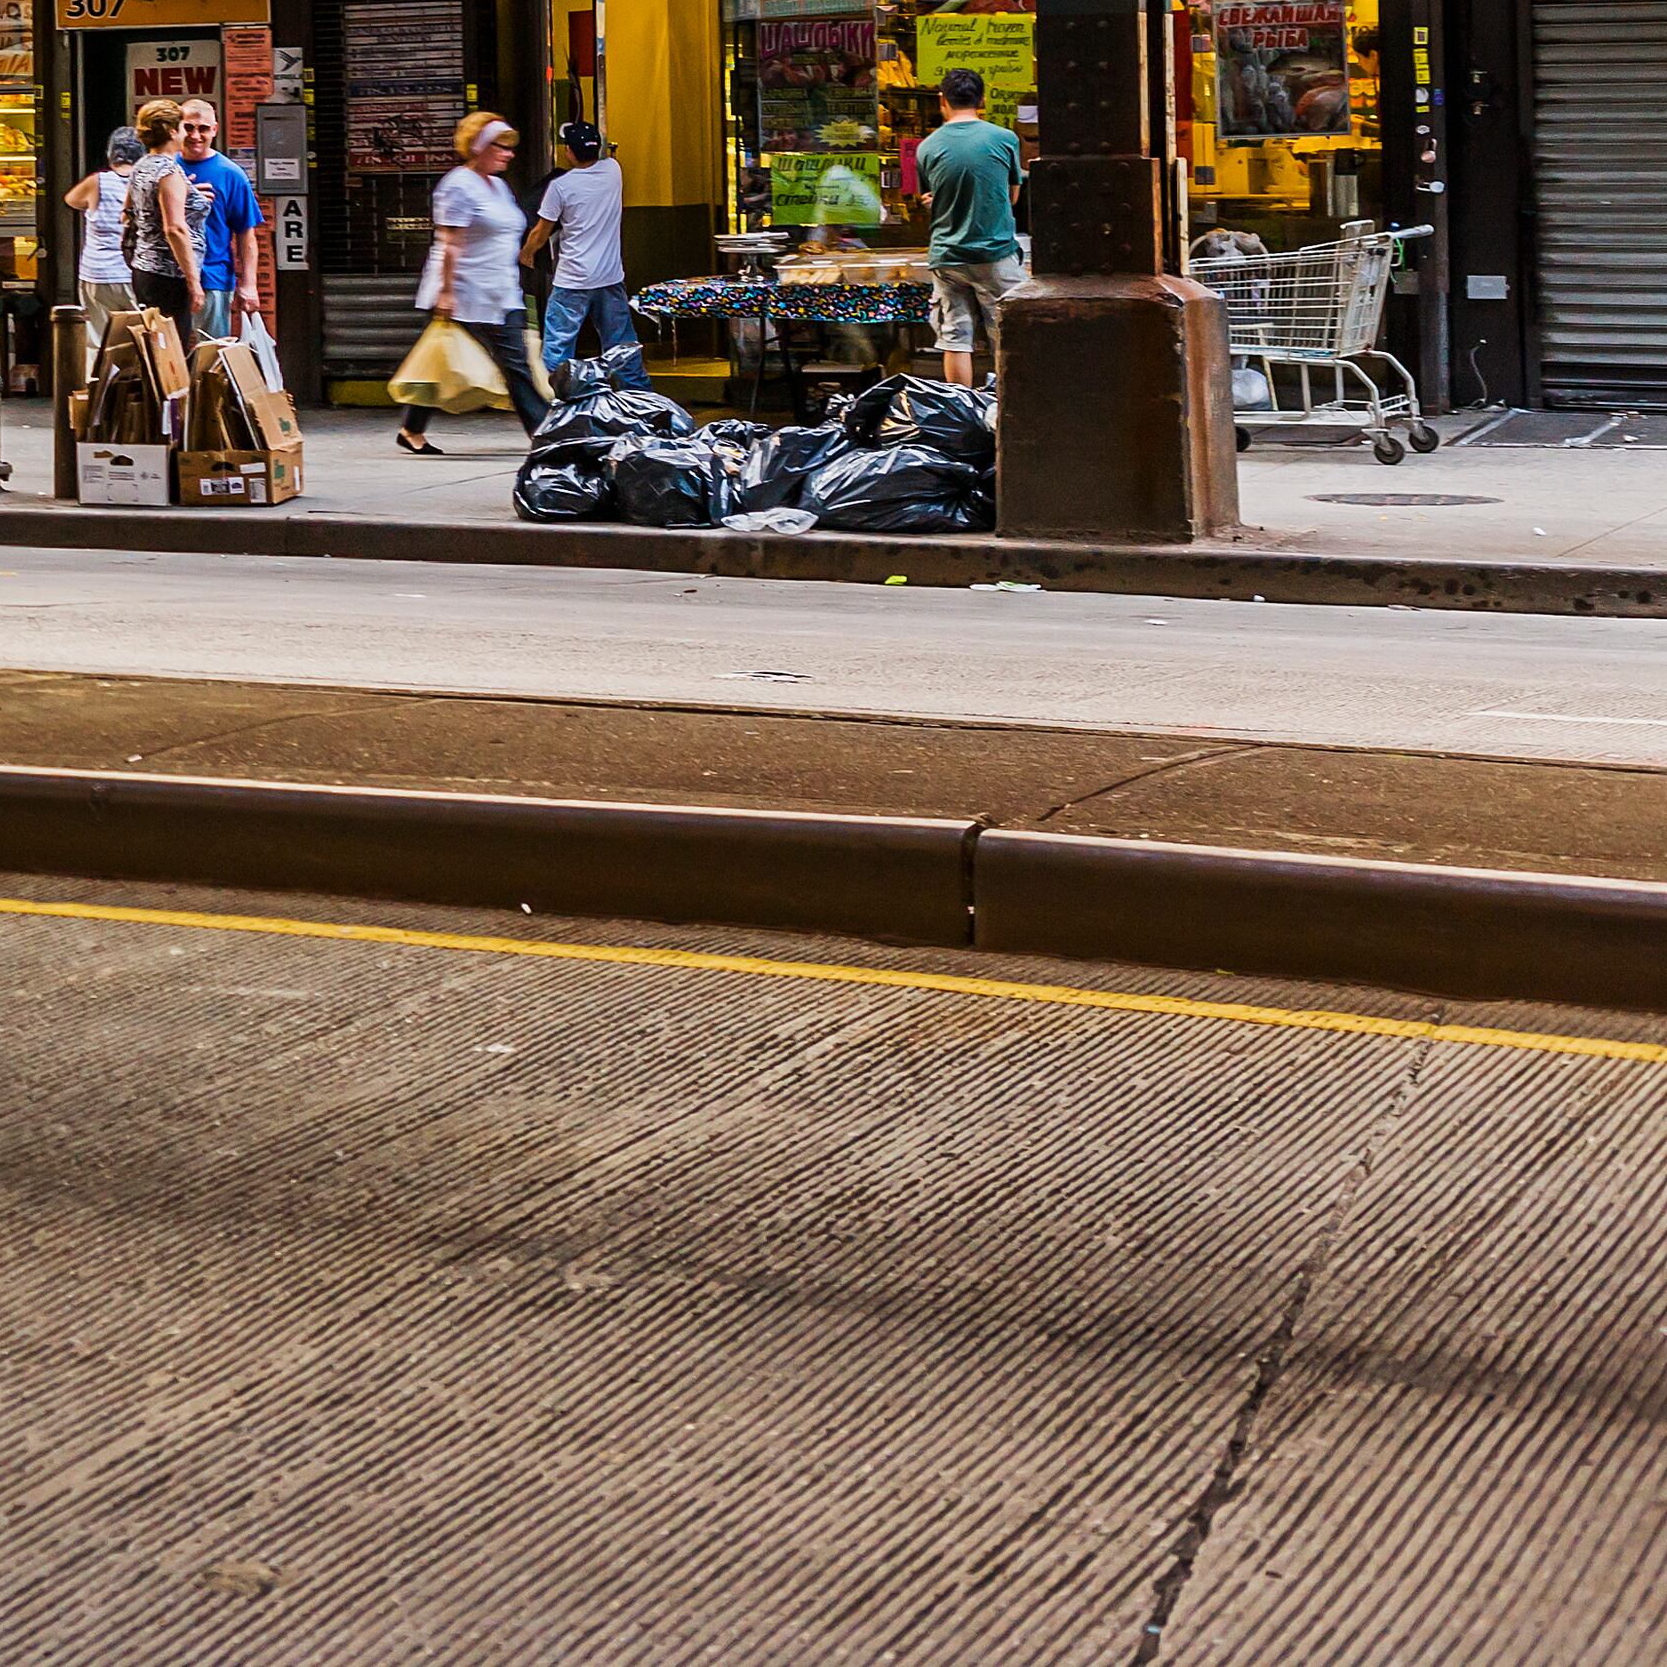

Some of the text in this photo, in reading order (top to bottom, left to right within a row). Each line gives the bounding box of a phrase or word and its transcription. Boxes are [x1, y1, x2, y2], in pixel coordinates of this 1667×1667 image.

[1253, 28, 1309, 49] РЫБА
[156, 46, 190, 63] 307
[134, 66, 217, 97] NEW
